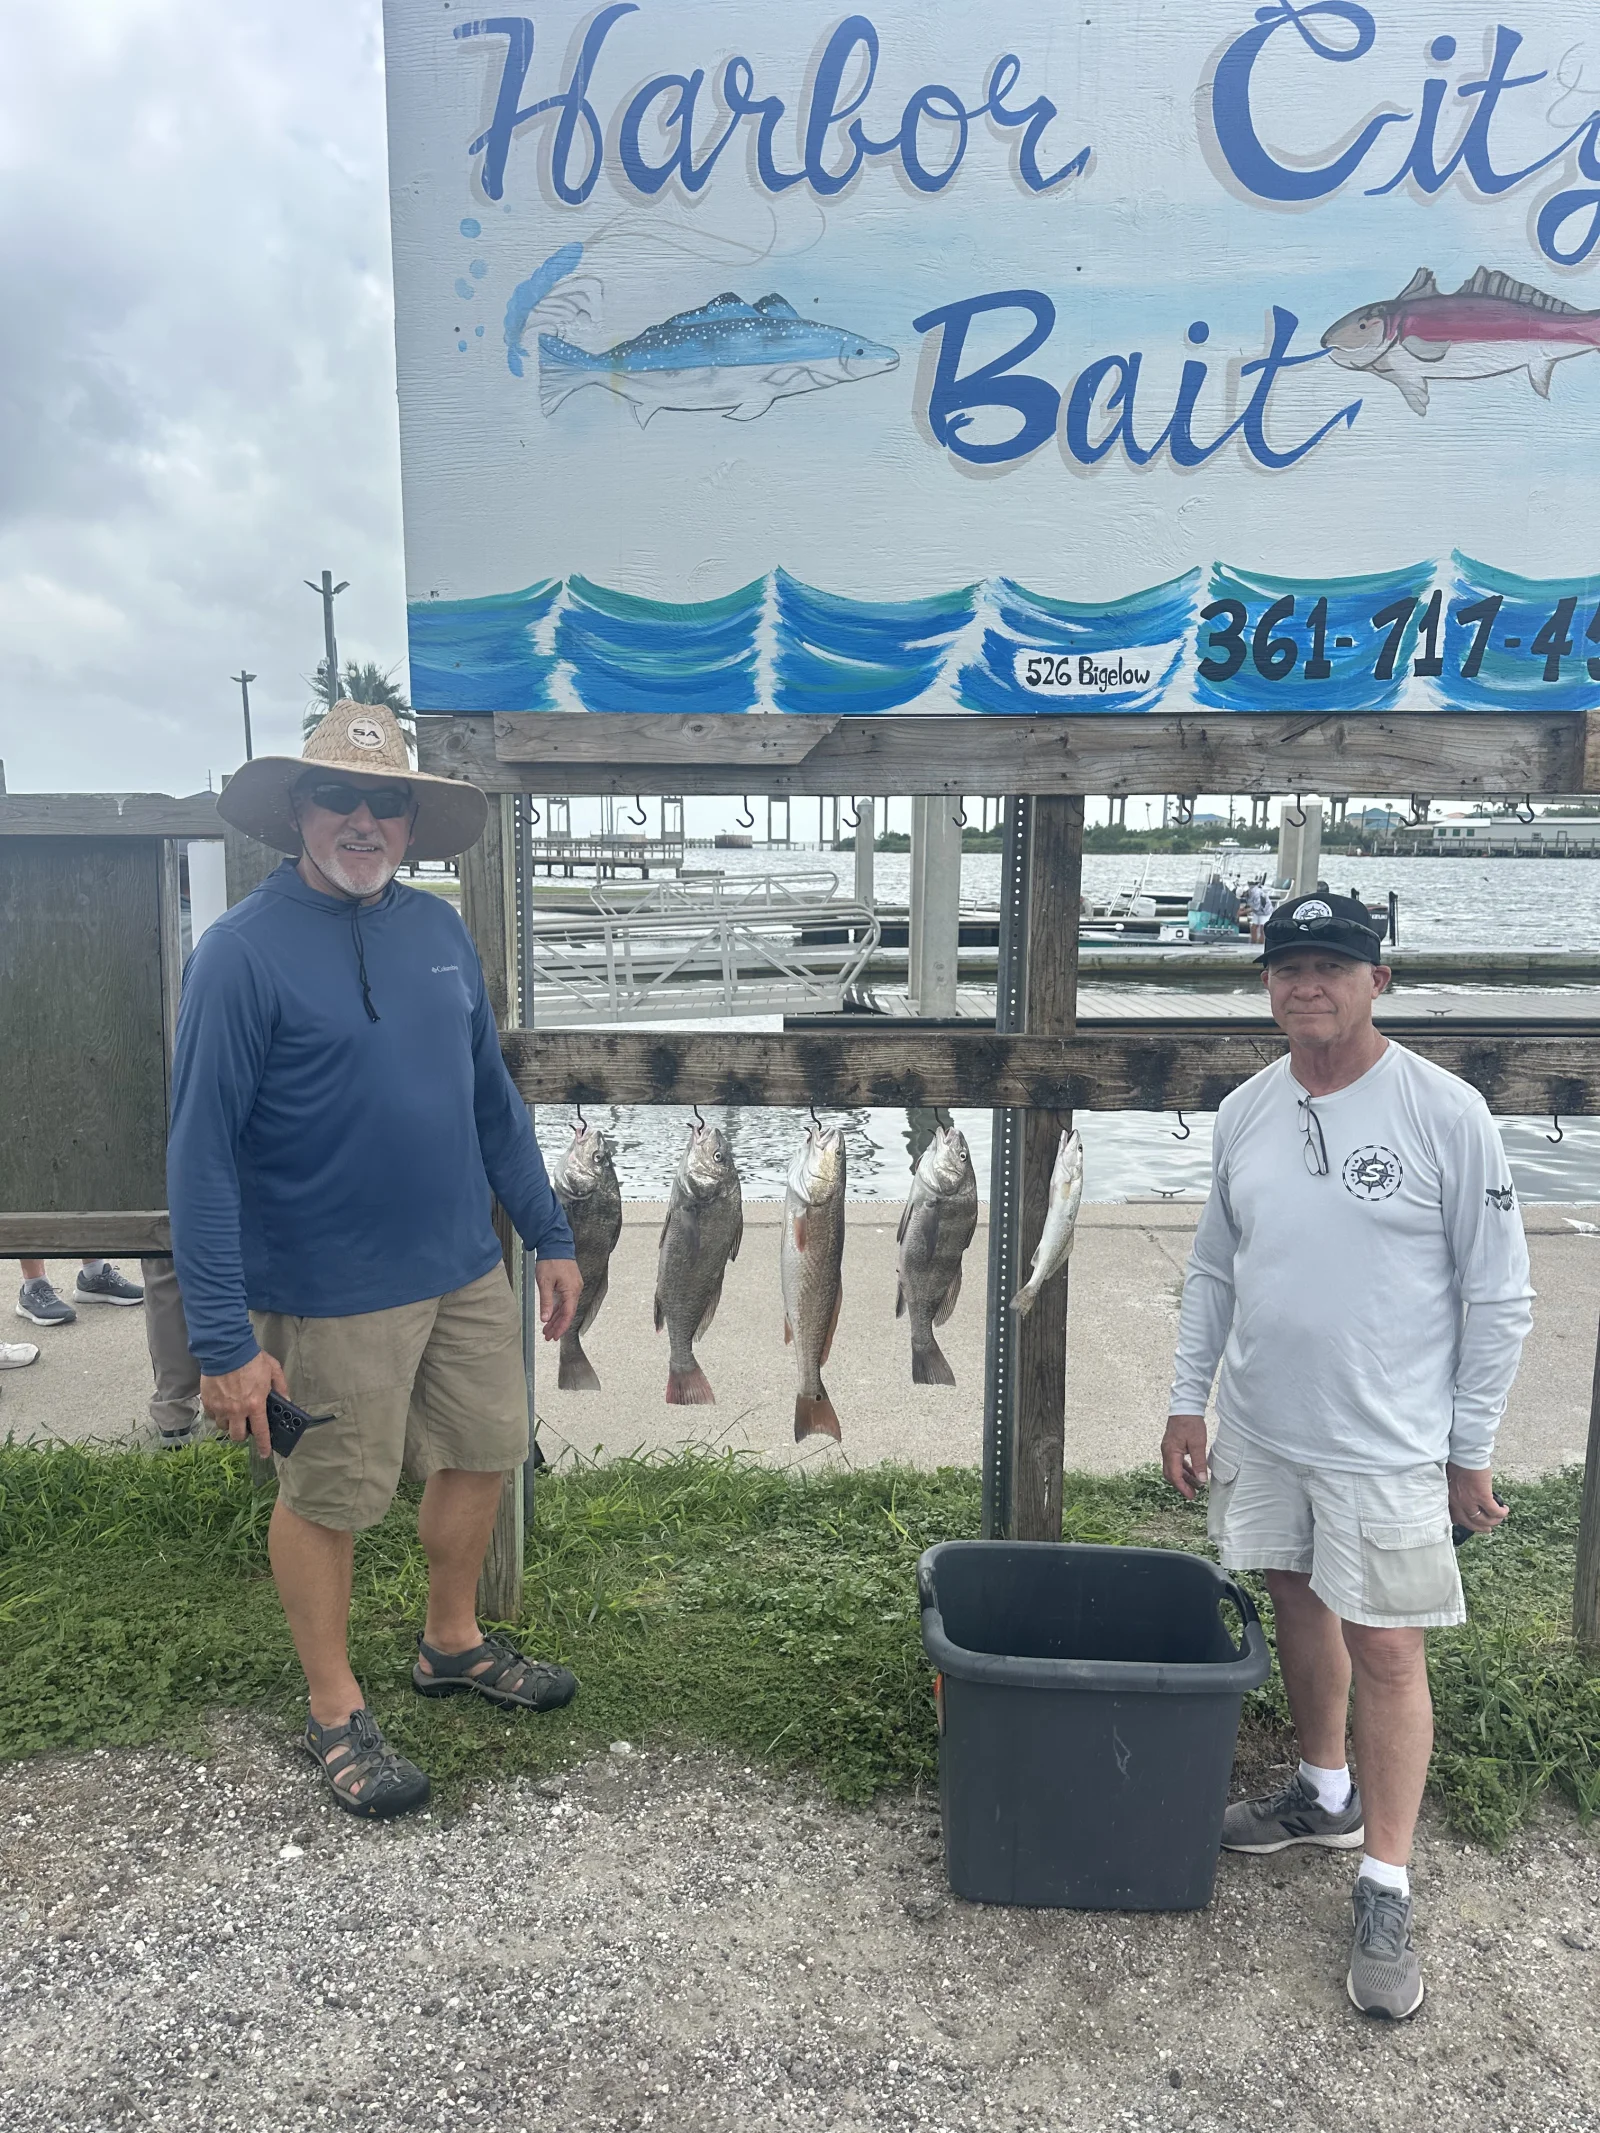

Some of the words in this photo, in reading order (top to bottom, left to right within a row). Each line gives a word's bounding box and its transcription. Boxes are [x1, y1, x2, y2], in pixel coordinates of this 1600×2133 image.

[453, 3, 1091, 205] Harbor
[912, 289, 1362, 468] Bait
[1025, 656, 1072, 687] 526
[1078, 655, 1151, 693] Bigelow
[353, 729, 380, 739] SA
[1361, 1163, 1385, 1182] S
